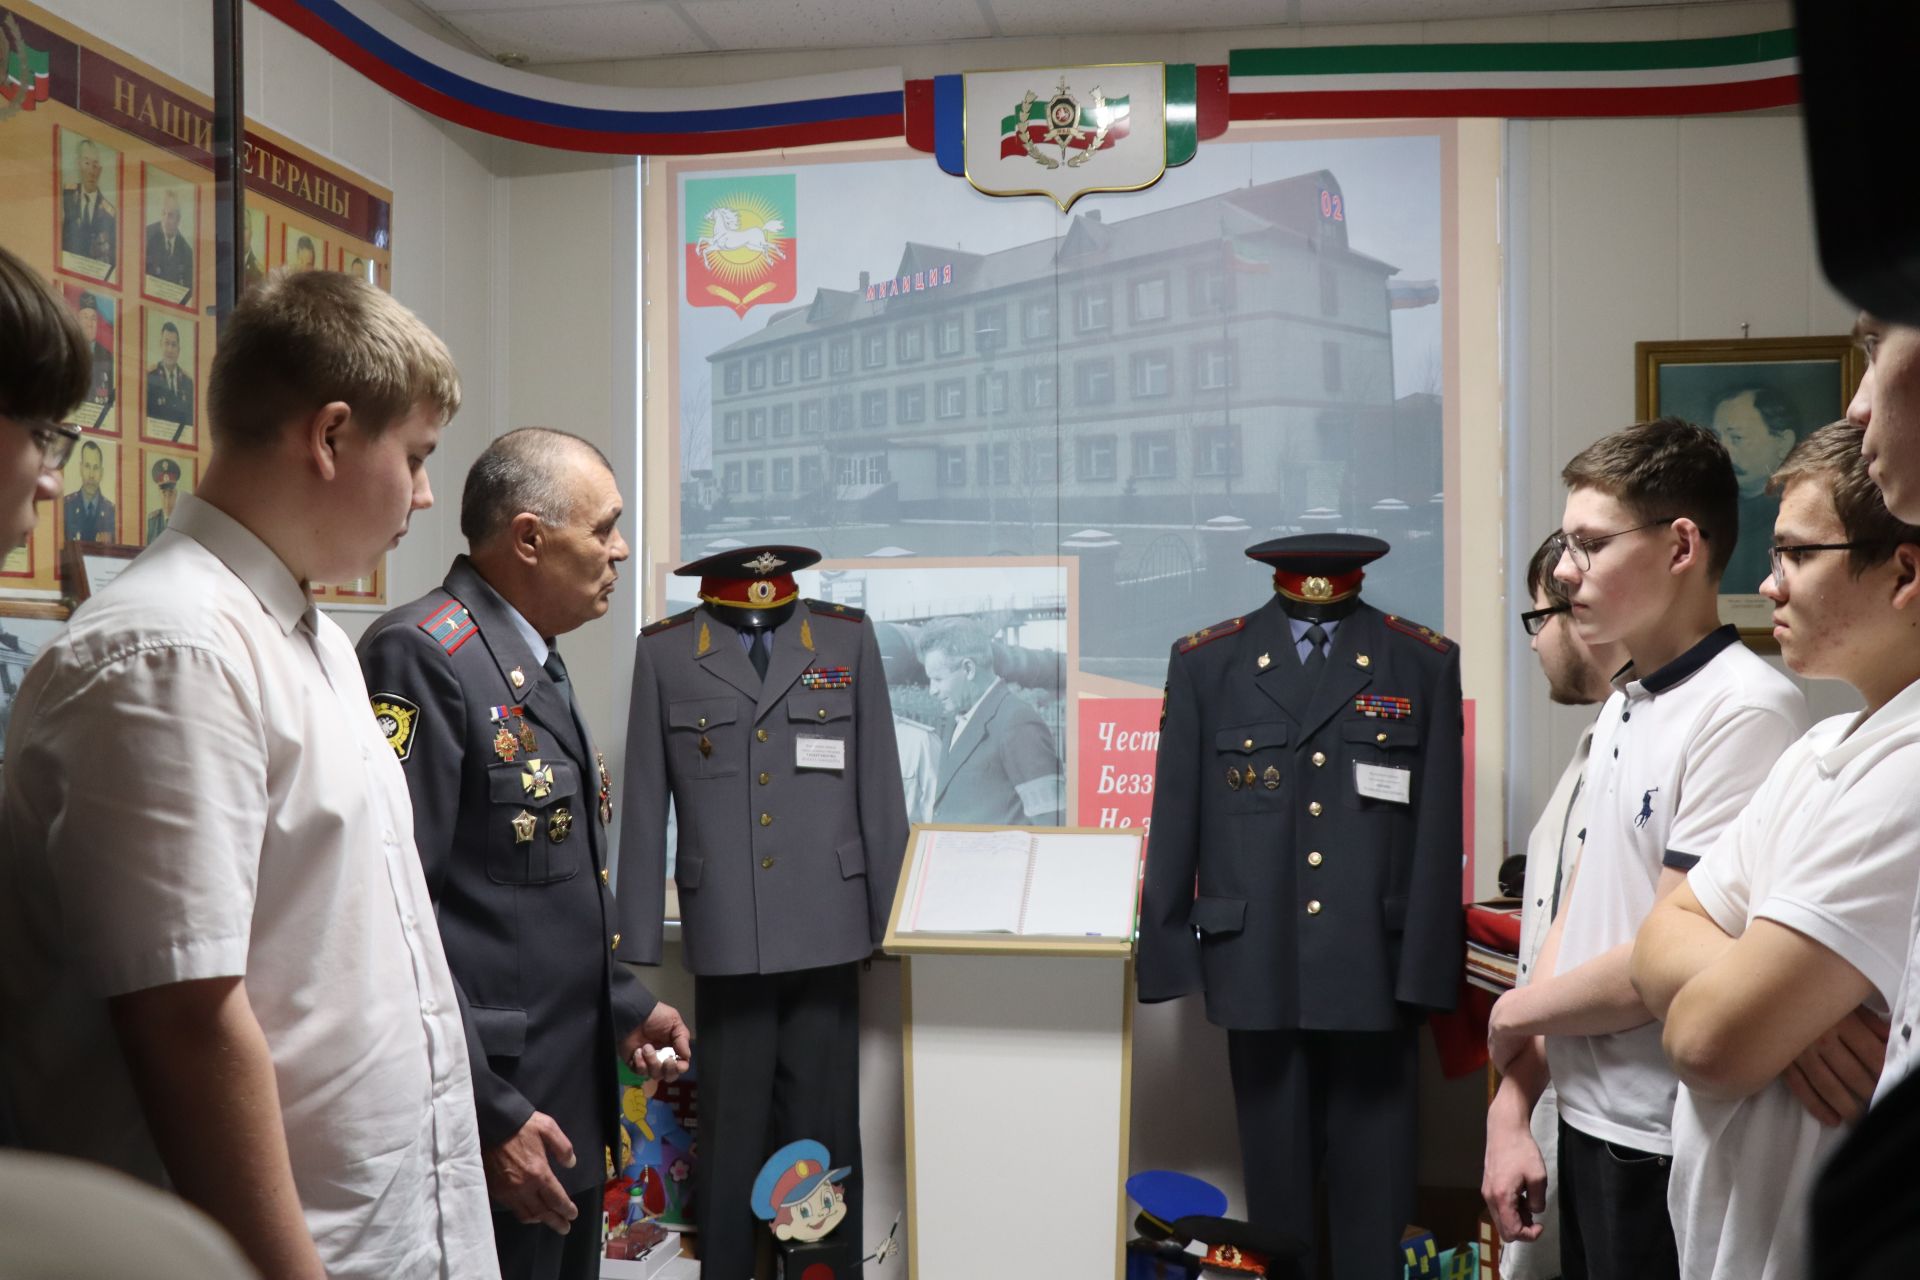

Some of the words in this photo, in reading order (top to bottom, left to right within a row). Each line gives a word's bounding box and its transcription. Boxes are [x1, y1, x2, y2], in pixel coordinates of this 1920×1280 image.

[112, 75, 214, 154] НАШИ
[242, 140, 351, 220] ЕТЕРАНЫ
[1320, 190, 1344, 221] 02
[865, 263, 952, 302] МИЛИЦИЯ
[1098, 722, 1160, 752] Чест
[1096, 765, 1153, 794] Безз
